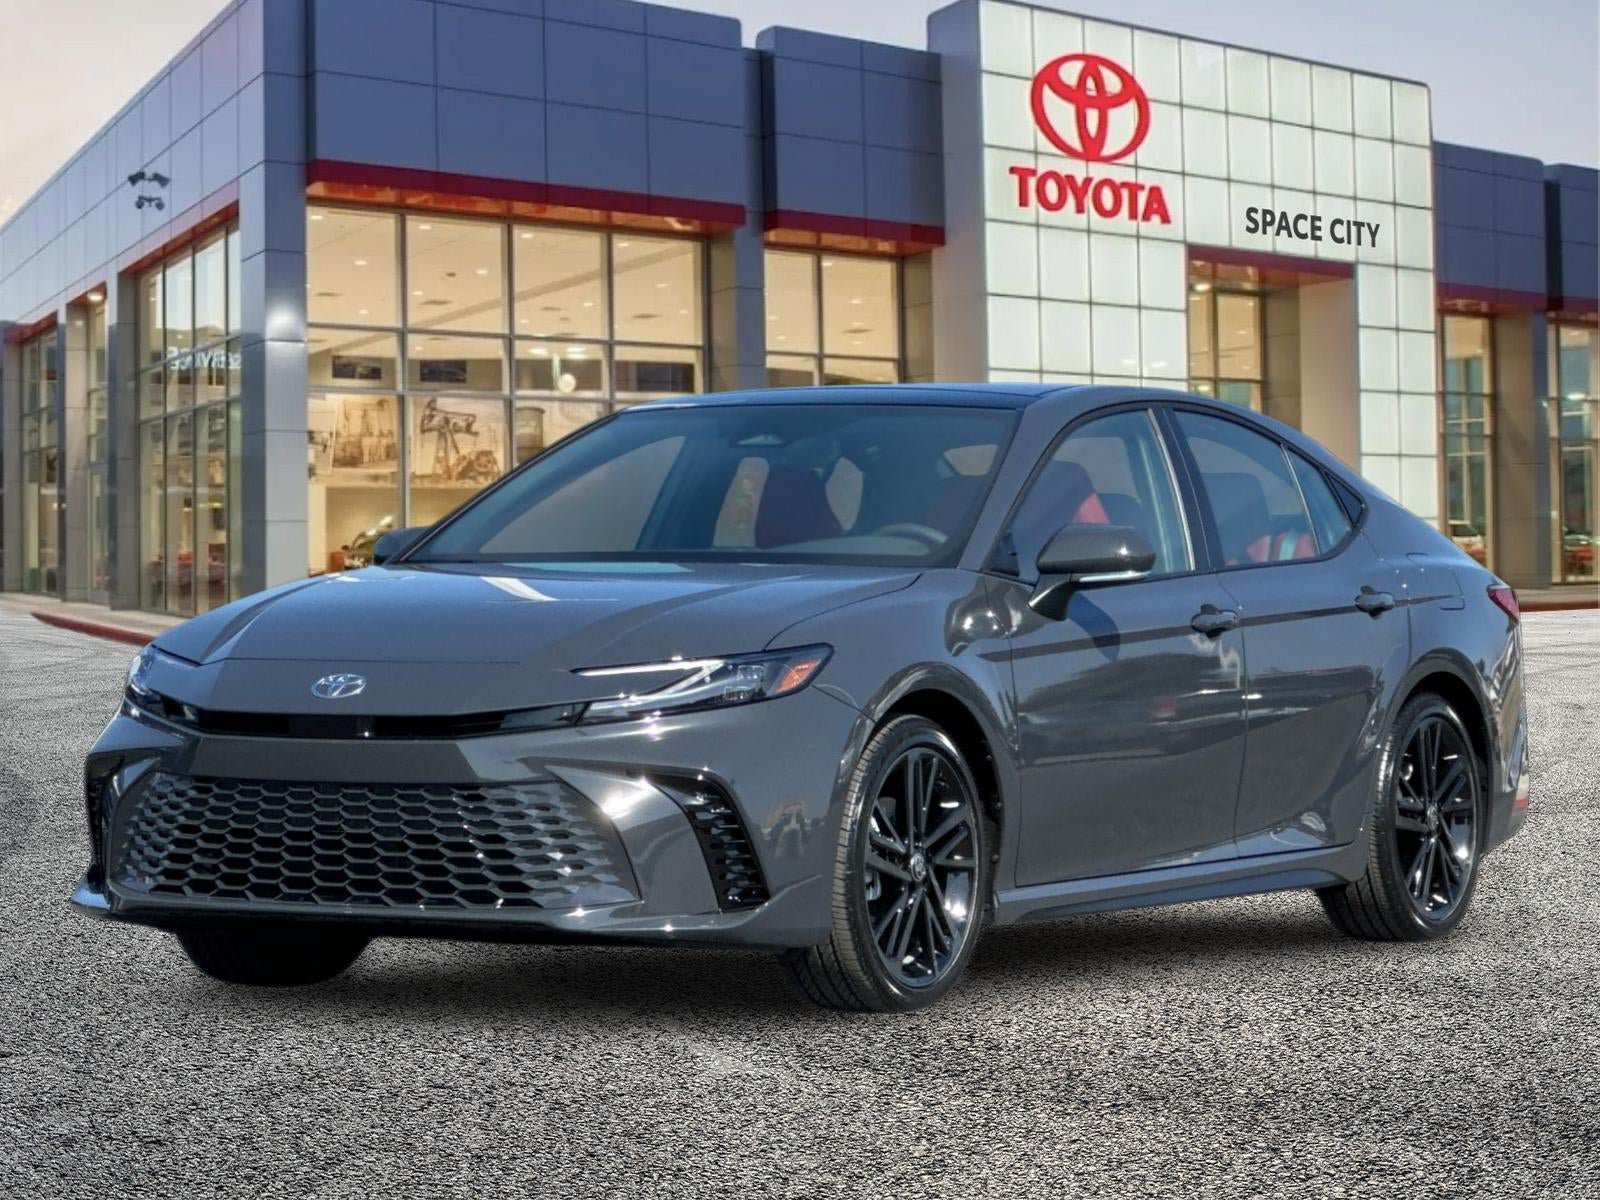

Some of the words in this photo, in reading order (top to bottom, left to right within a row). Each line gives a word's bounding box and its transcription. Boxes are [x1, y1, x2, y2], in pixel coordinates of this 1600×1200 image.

[1009, 166, 1171, 224] TOYOTA
[1245, 206, 1323, 241] SPACE
[1329, 218, 1380, 248] CITY
